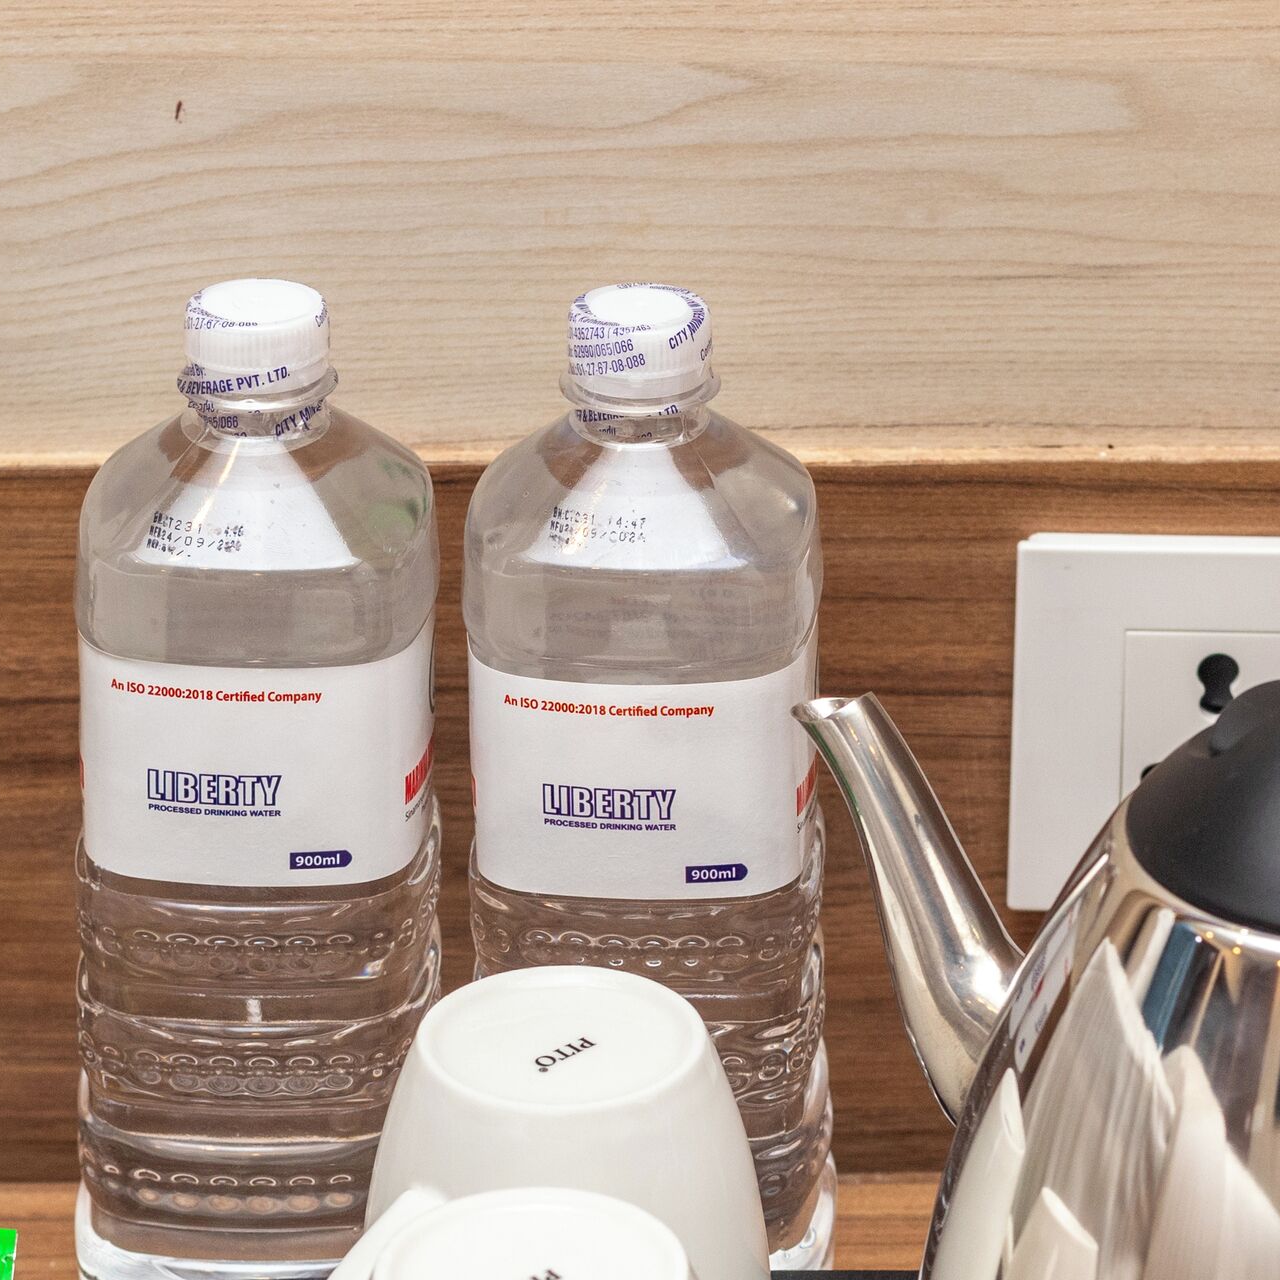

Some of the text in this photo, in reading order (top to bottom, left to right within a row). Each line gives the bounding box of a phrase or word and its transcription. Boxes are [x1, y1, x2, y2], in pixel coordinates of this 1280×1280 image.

[669, 328, 688, 349] CITY
[186, 379, 233, 395] BEVERAGE
[236, 374, 265, 390] PVT.
[267, 366, 290, 383] LTD.
[111, 678, 322, 704] An ISO 22000:2018 Certified Company
[504, 694, 714, 718] An ISO 22000:2018 Certified Company
[147, 768, 282, 806] LIBERTY
[148, 803, 281, 817] PROCESSED DRINKING WATER
[542, 783, 676, 820] LIBERTY
[544, 818, 676, 831] PROCESSED DRINKING WATER
[295, 853, 340, 866] 900ml
[691, 867, 736, 880] 900ml
[535, 1037, 596, 1067] PITO
